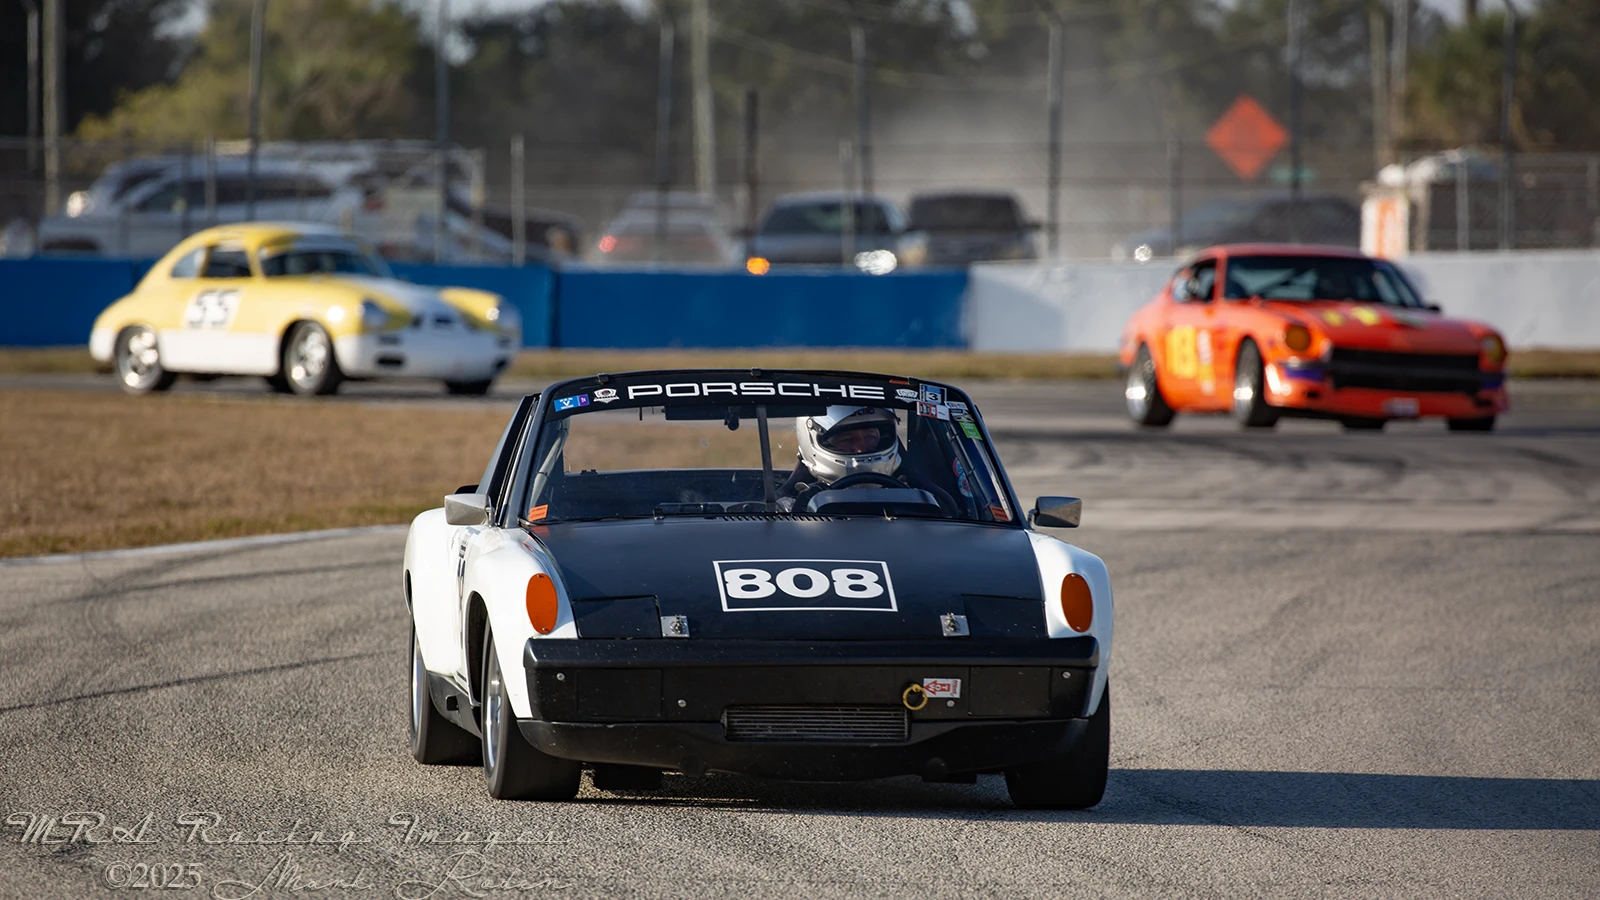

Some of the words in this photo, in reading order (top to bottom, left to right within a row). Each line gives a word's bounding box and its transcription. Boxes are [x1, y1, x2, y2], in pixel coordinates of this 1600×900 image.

[188, 288, 241, 328] 55
[628, 382, 885, 399] PORSCHE
[928, 393, 938, 401] 3
[723, 567, 884, 599] 808
[928, 683, 948, 692] TOW
